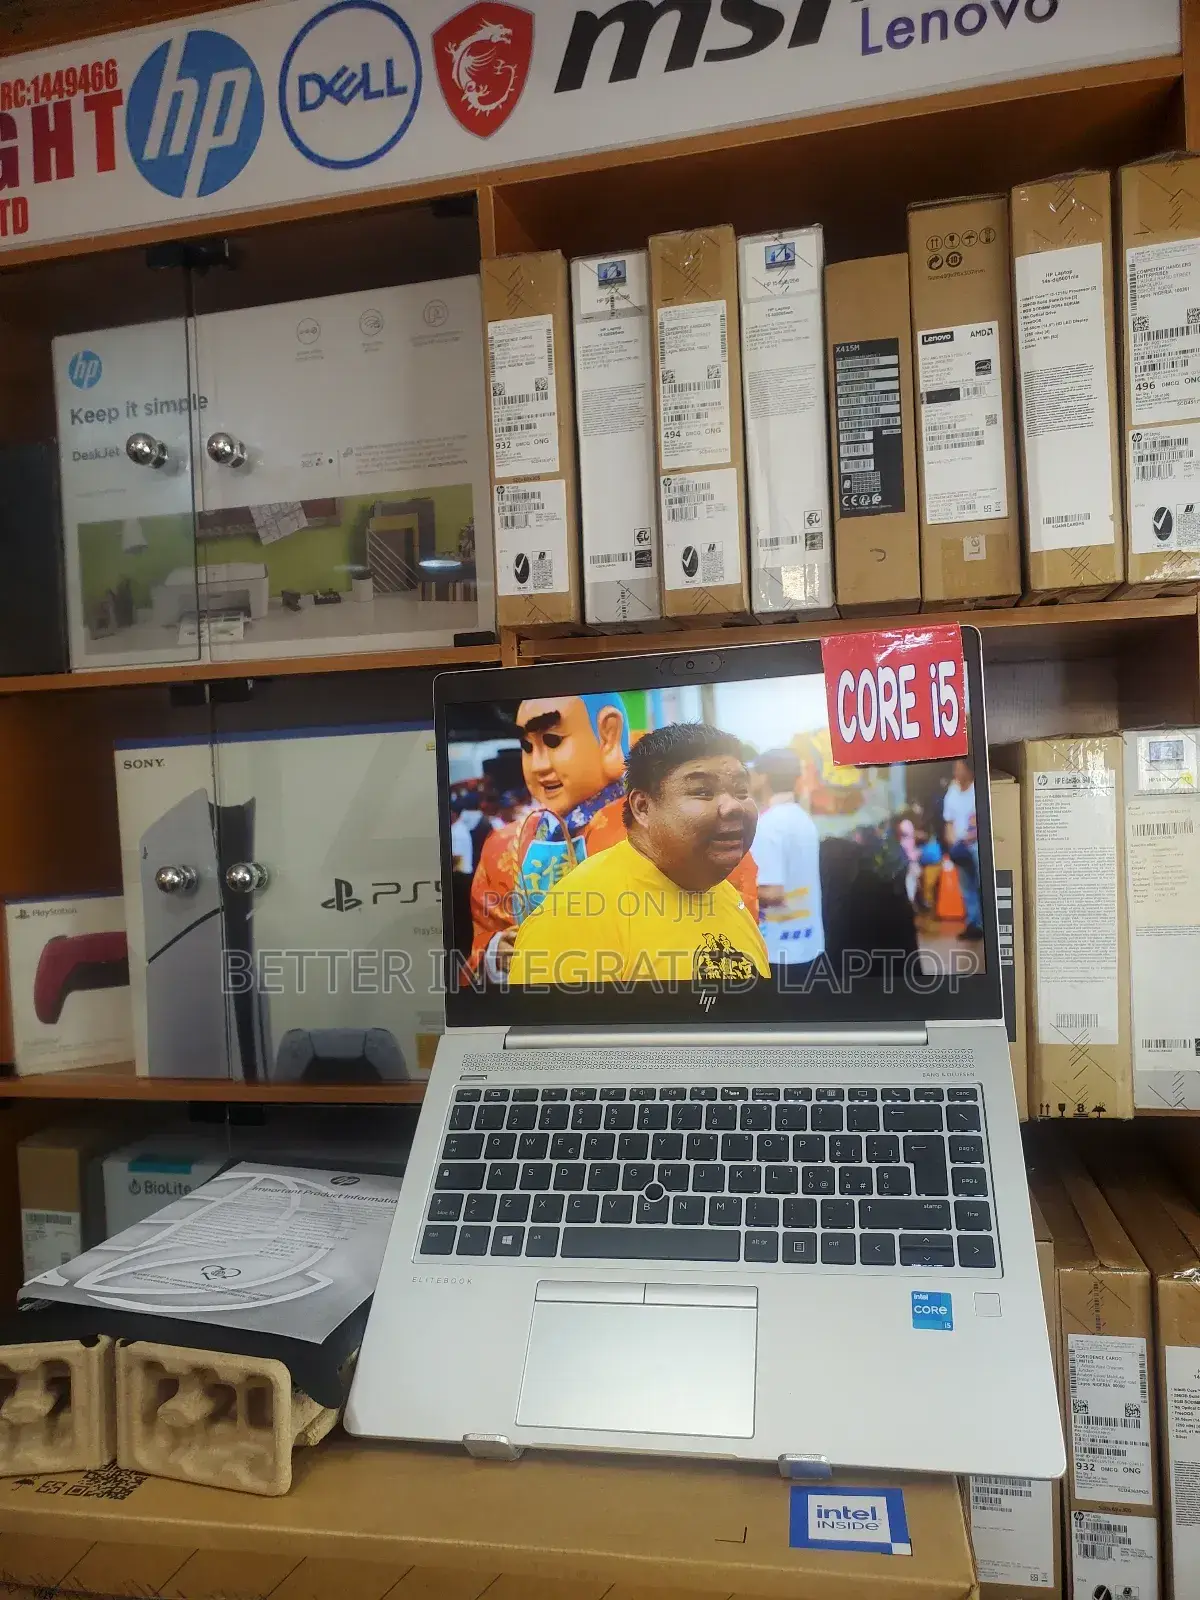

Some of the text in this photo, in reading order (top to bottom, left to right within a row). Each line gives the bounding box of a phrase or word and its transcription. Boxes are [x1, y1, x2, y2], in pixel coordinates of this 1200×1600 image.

[861, 0, 1058, 56] Lenovo
[0, 58, 118, 111] RC:1449466
[299, 57, 408, 114] DELL
[143, 30, 251, 199] hp
[924, 333, 952, 344] Lenovo
[970, 328, 988, 338] AMD
[836, 344, 860, 354] X415M
[1136, 380, 1156, 391] 496
[70, 392, 208, 425] Keep it simple
[664, 431, 682, 439] 494
[495, 441, 512, 450] 932
[534, 438, 550, 446] ONG
[72, 446, 121, 462] DeskJet
[838, 661, 960, 743] CORE i5
[123, 758, 165, 770] SONY
[372, 880, 442, 905] PS
[32, 907, 78, 918] PlayStation
[698, 988, 716, 1012] hp
[144, 1180, 192, 1195] BioLite
[252, 1186, 302, 1195] Important
[304, 1190, 344, 1199] Product
[412, 1276, 473, 1284] ELITEBOOK
[1076, 1462, 1096, 1472] 932
[816, 1504, 878, 1522] intel
